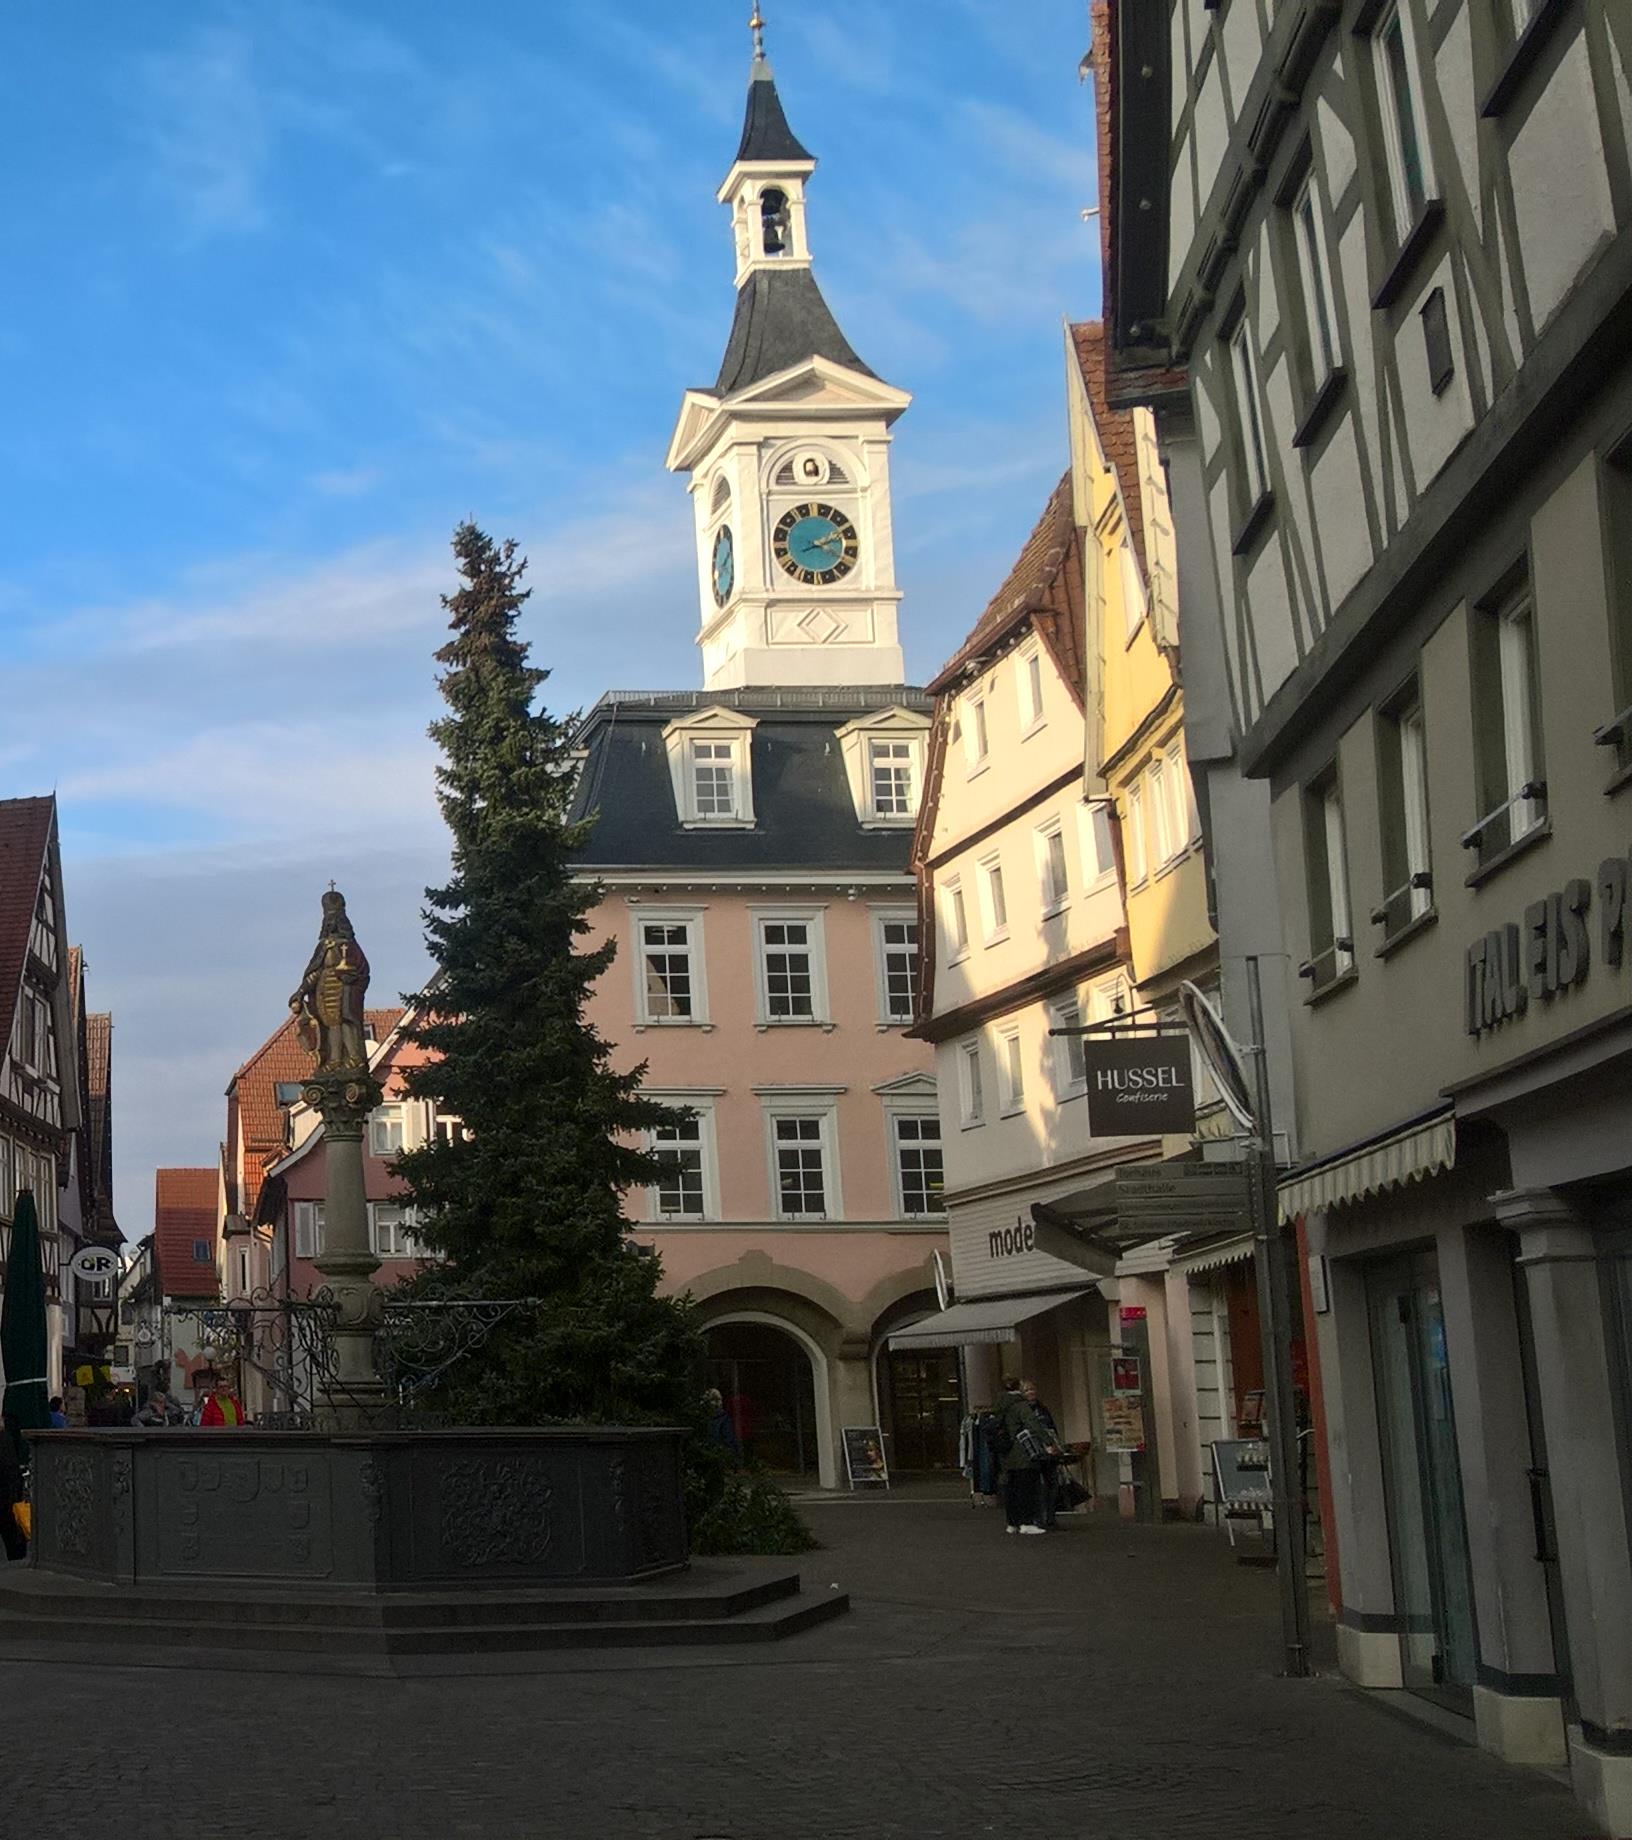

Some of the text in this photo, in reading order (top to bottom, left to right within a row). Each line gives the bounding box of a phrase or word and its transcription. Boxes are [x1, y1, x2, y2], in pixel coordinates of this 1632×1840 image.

[1597, 847, 1632, 969] P
[1097, 1066, 1185, 1091] HUSSEL
[988, 1215, 1034, 1259] mode
